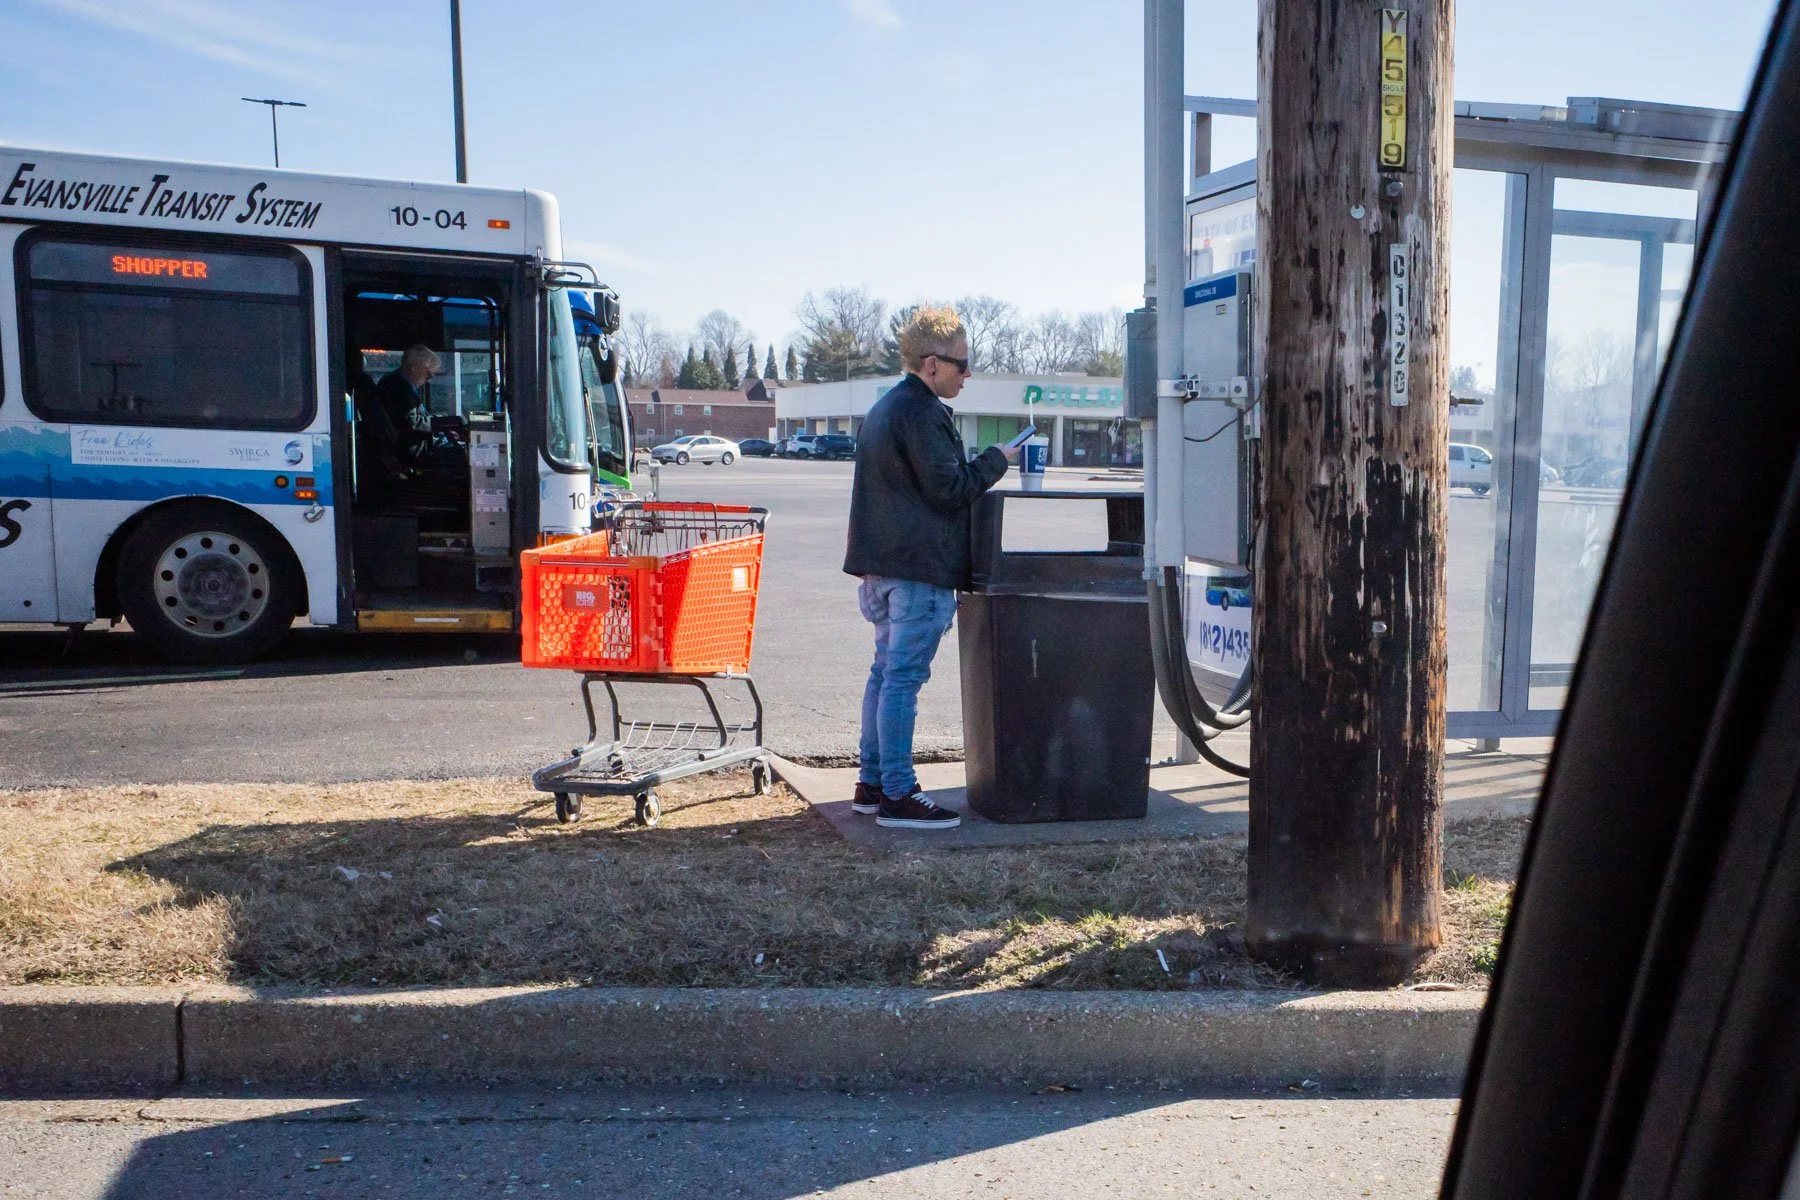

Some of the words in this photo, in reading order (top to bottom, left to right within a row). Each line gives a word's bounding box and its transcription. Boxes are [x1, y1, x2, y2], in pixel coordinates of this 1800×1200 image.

[391, 207, 467, 230] 10-04
[111, 255, 208, 278] SHOPPER
[77, 430, 108, 446] Free
[114, 431, 153, 449] Rides
[229, 447, 270, 457] SWIRCA
